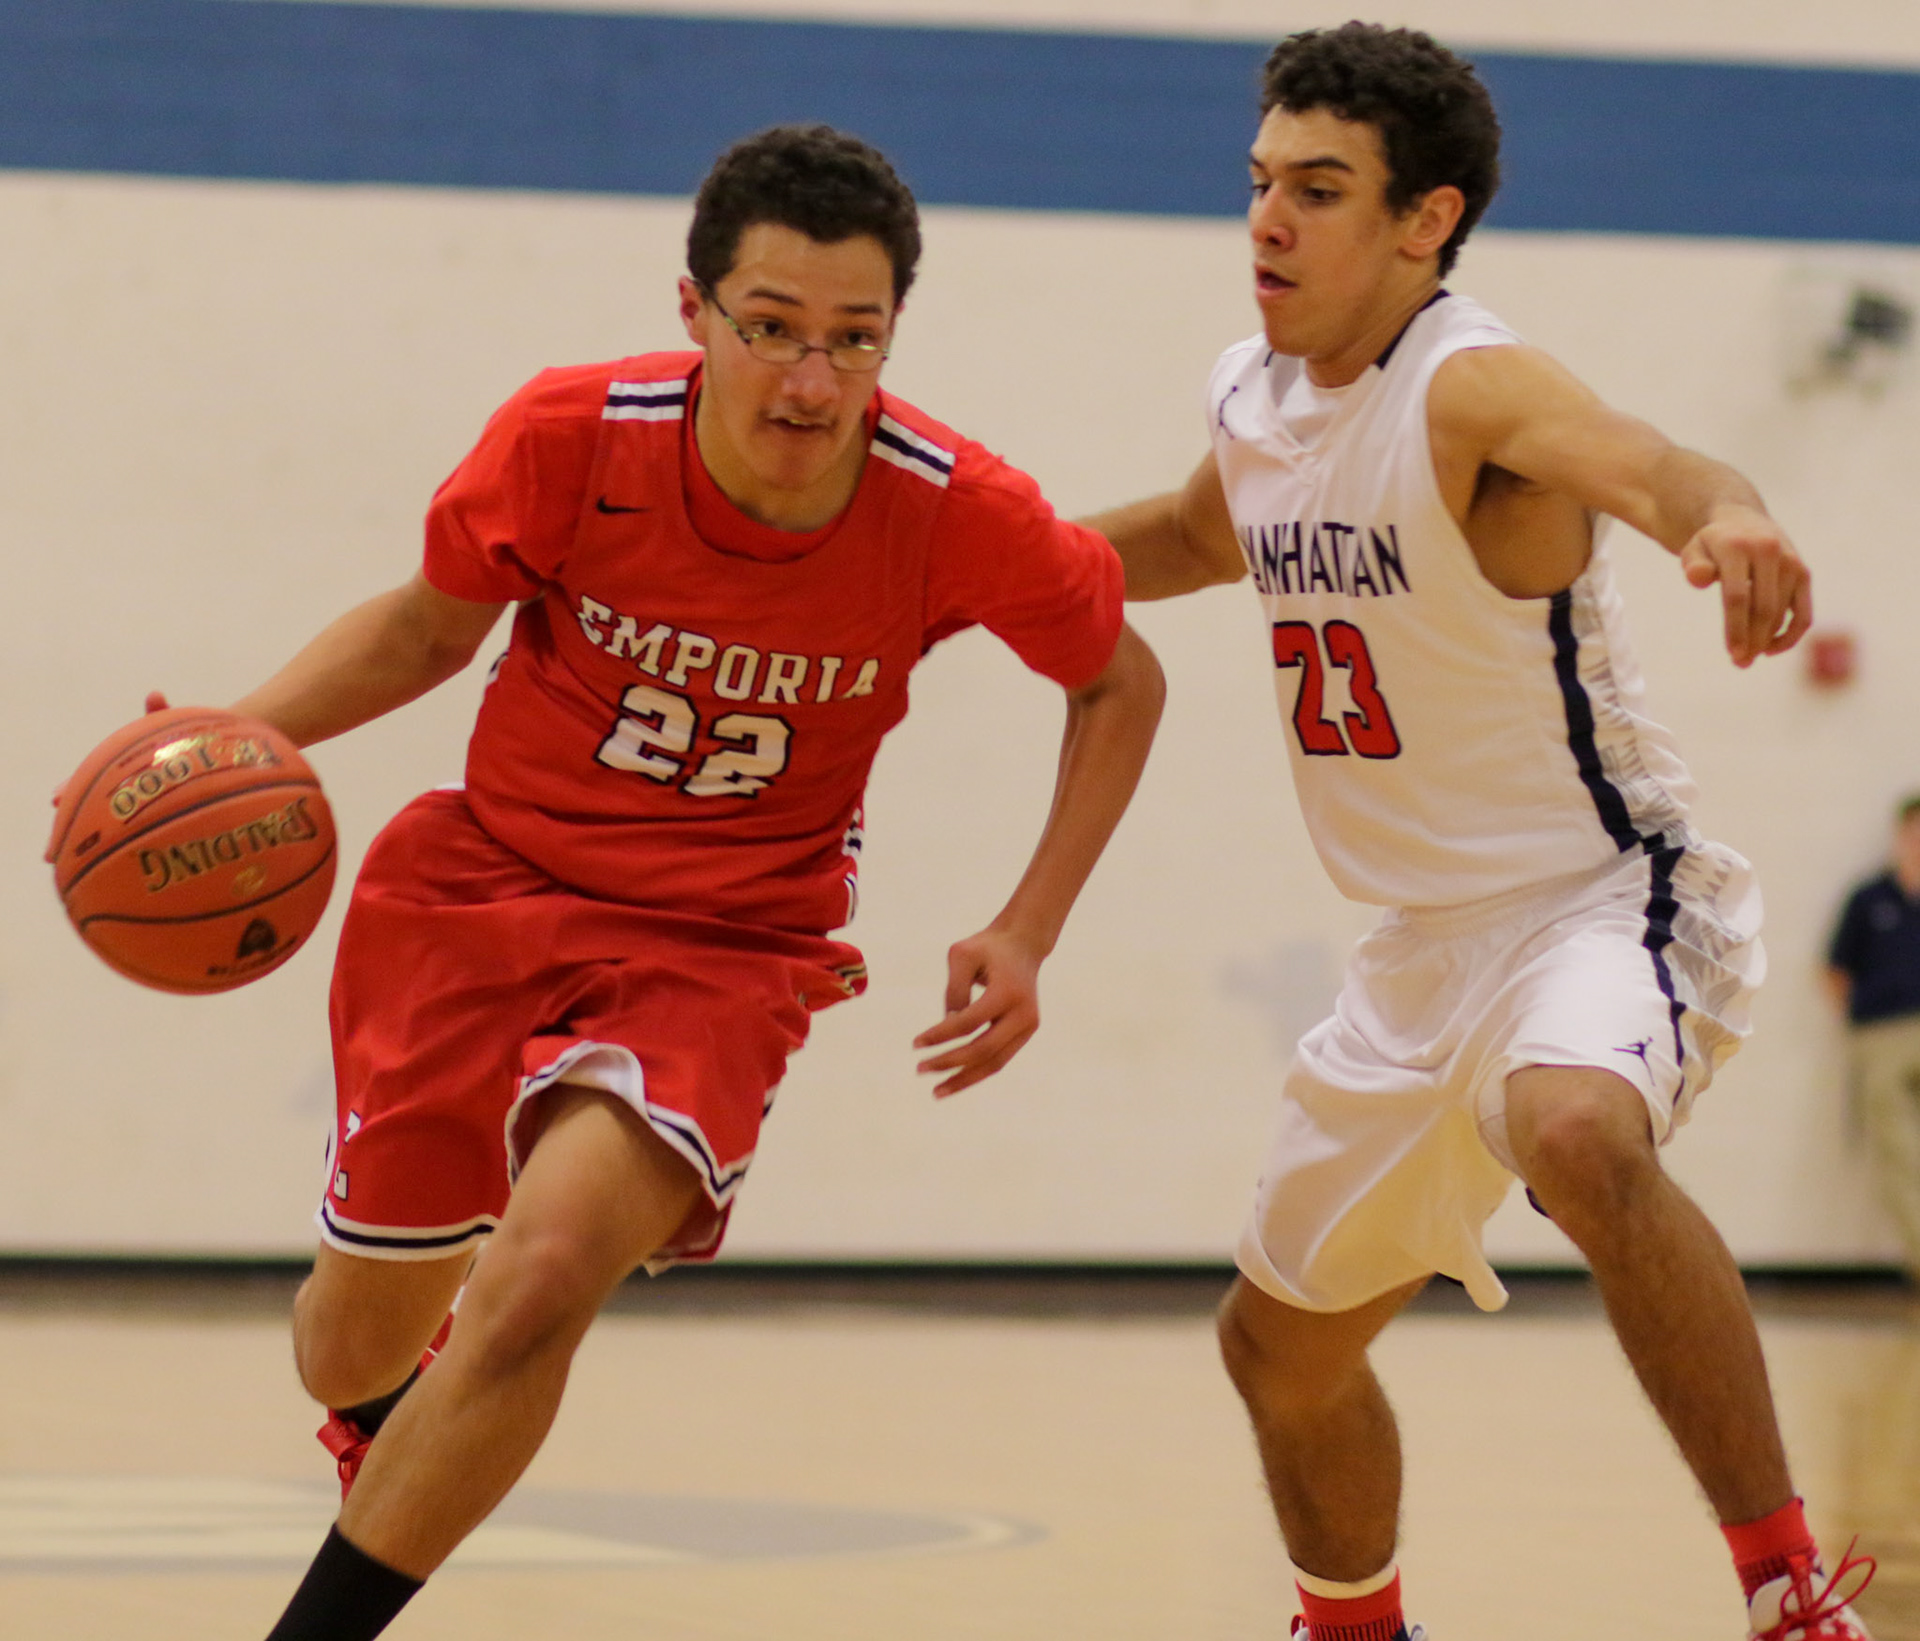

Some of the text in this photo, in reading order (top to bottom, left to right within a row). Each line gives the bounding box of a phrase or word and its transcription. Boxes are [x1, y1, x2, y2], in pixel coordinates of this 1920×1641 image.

[577, 595, 879, 704] EMPORIA
[1272, 620, 1401, 759] 23
[594, 684, 795, 798] 22
[138, 797, 318, 892] SPALDING
